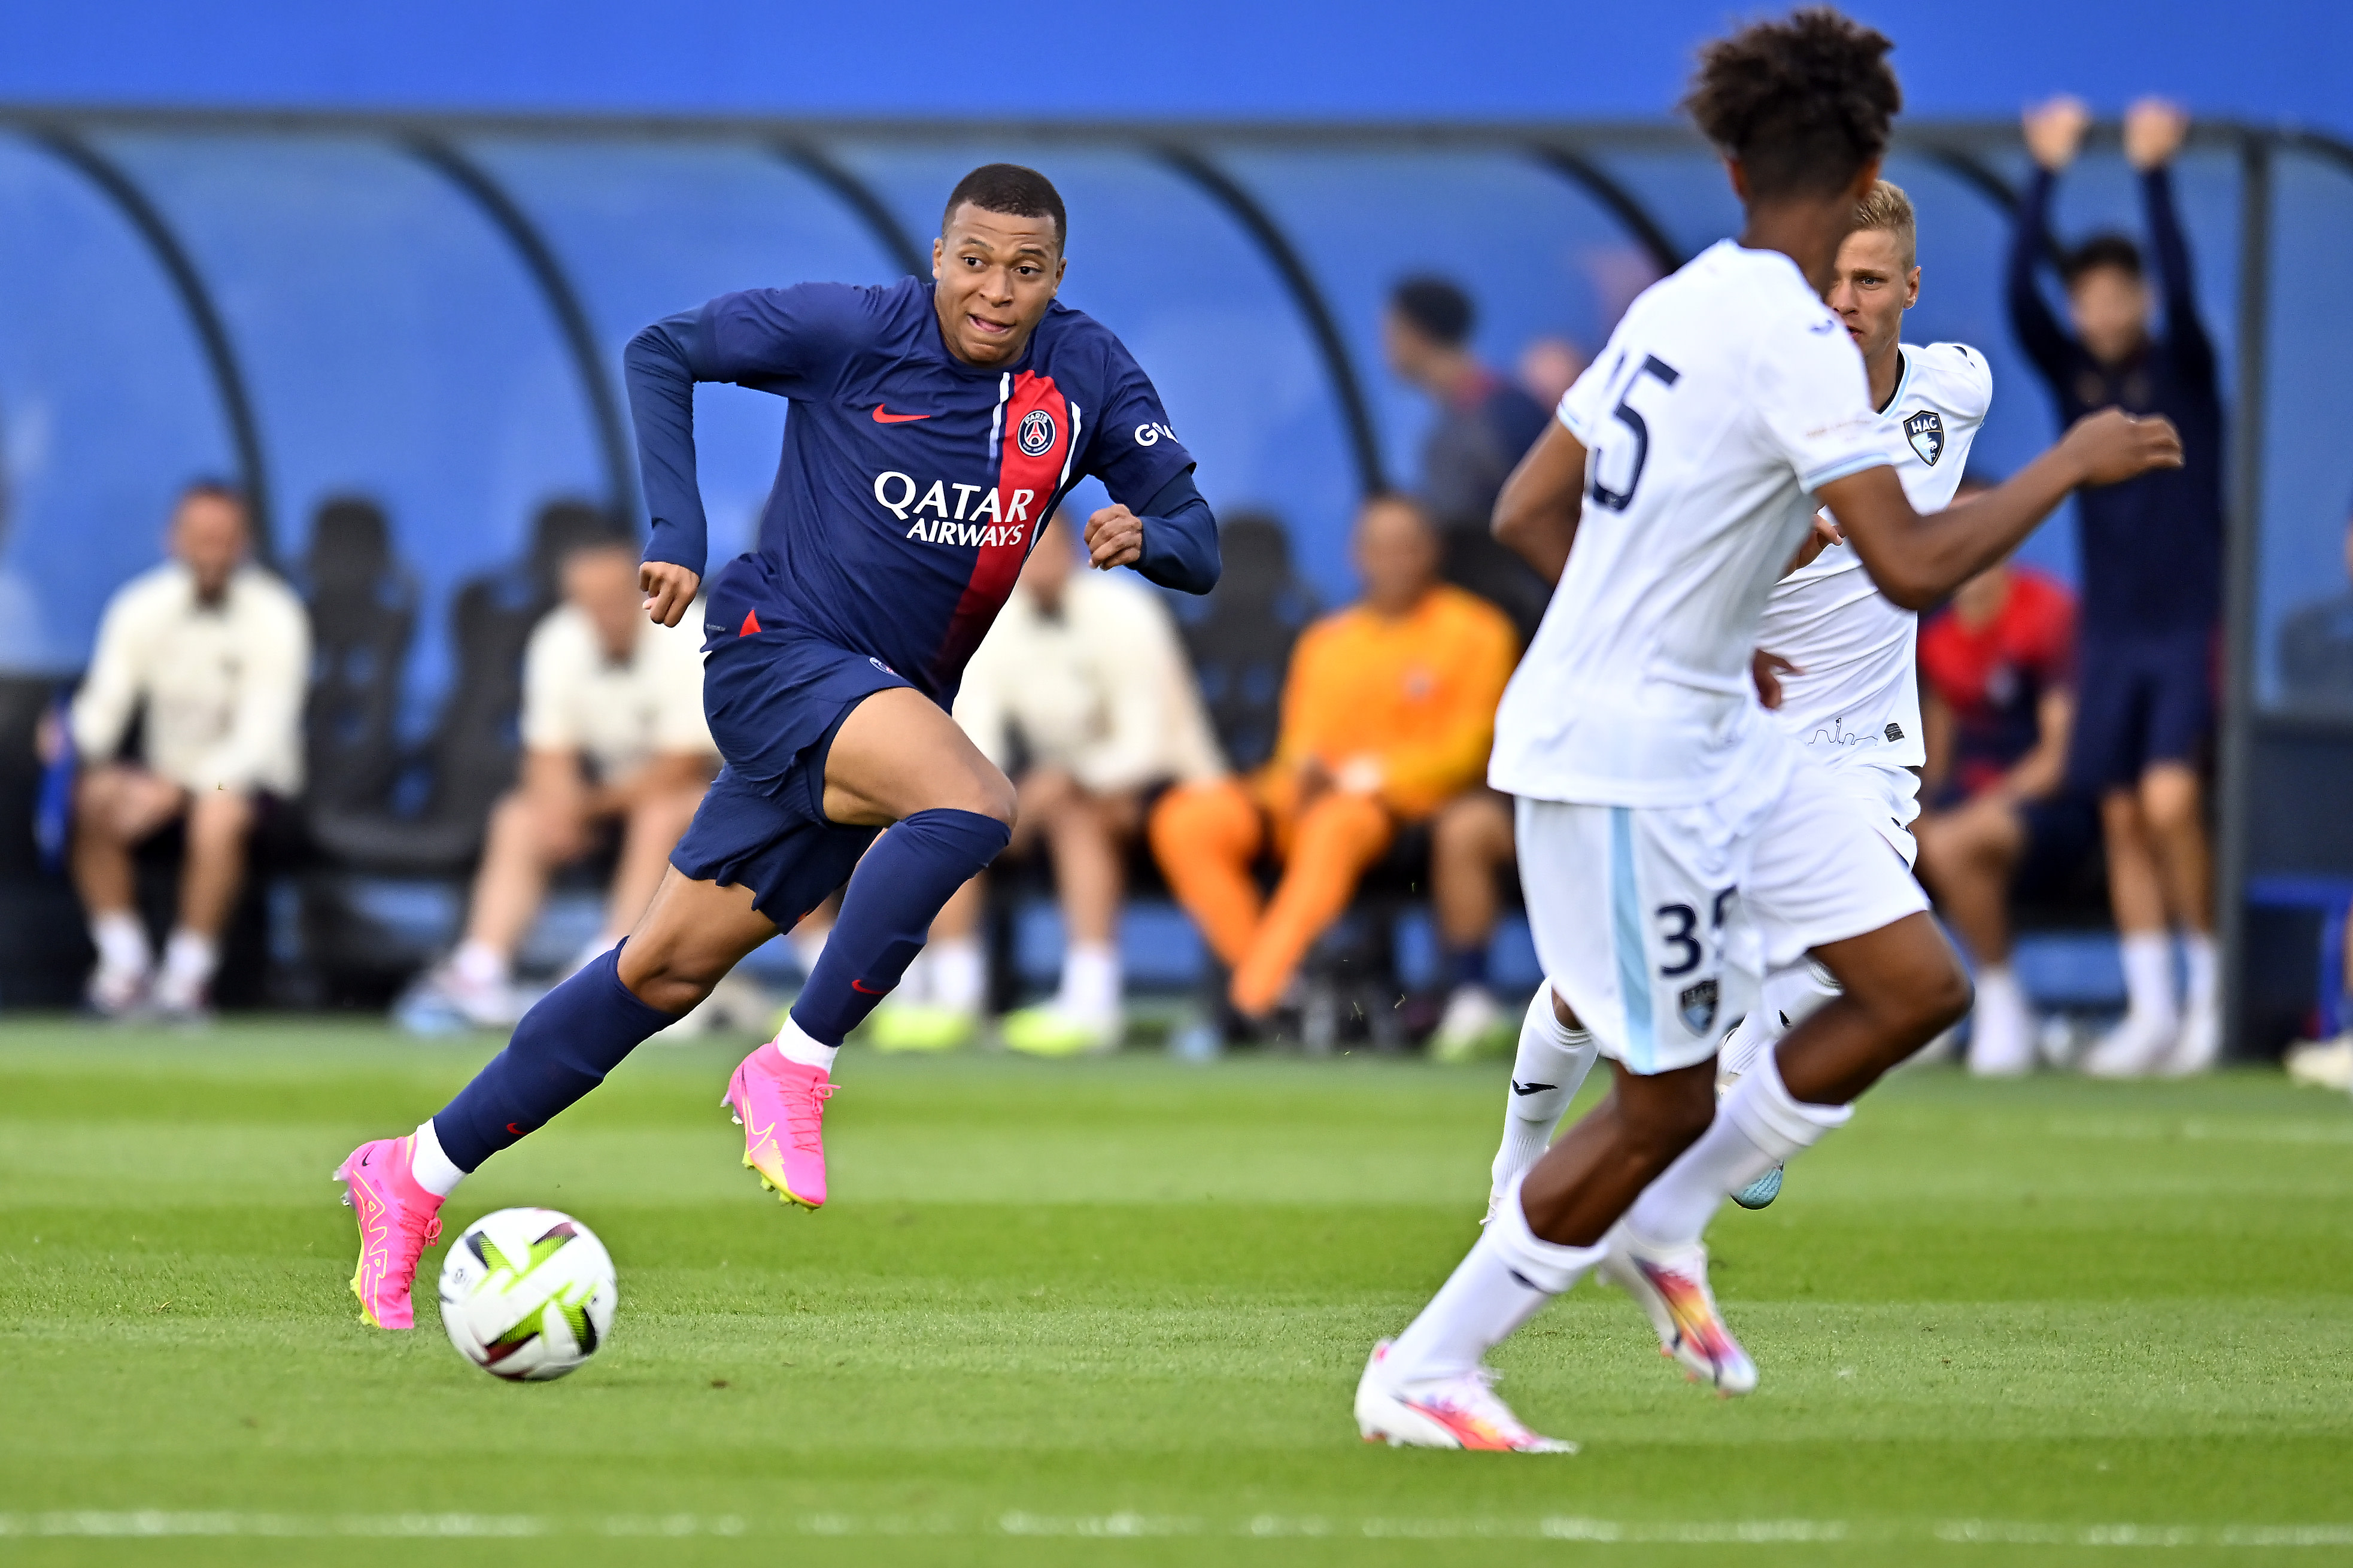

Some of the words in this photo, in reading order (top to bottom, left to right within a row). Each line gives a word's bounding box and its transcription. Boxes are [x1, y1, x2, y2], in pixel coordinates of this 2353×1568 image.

[1024, 413, 1048, 424] PARIS
[1911, 417, 1938, 433] HAC
[874, 471, 1035, 523] QATAR
[906, 518, 1025, 547] AIRWAYS
